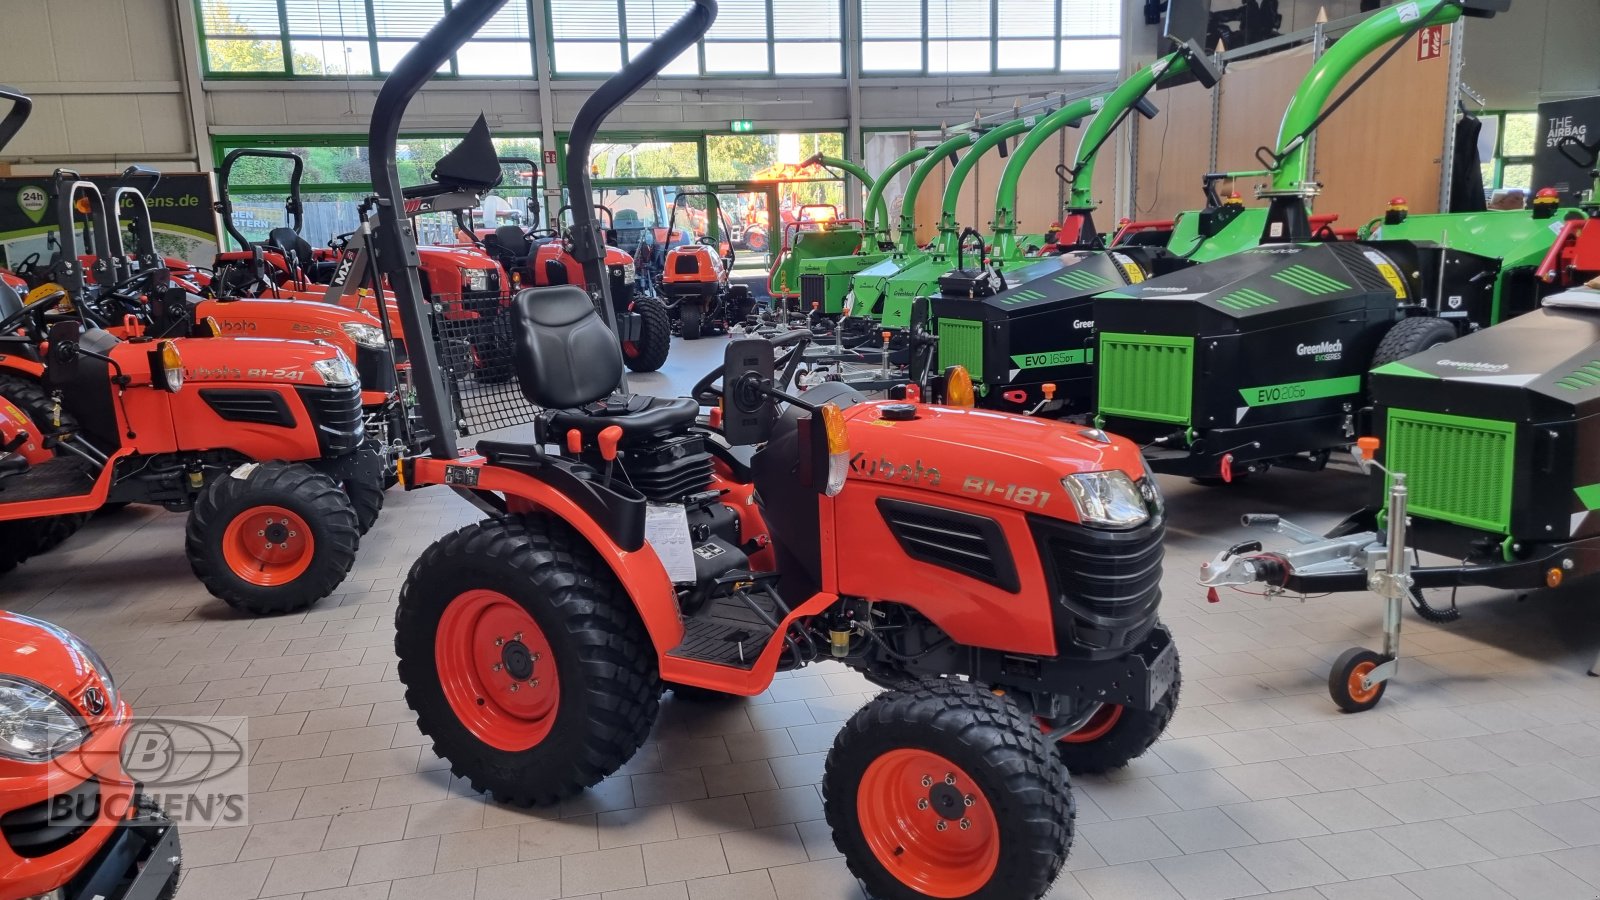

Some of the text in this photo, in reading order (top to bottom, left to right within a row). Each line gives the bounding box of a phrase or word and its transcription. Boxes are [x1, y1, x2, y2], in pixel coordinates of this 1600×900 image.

[1549, 116, 1573, 129] THE
[1547, 125, 1587, 138] AIRBAG
[1546, 135, 1586, 147] SYM
[23, 192, 43, 201] 24h
[334, 258, 353, 286] MX
[1296, 339, 1343, 355] GreenMech
[1025, 354, 1047, 366] EVO
[247, 368, 305, 381] B1-241
[849, 451, 1051, 509] Kubota B1-181
